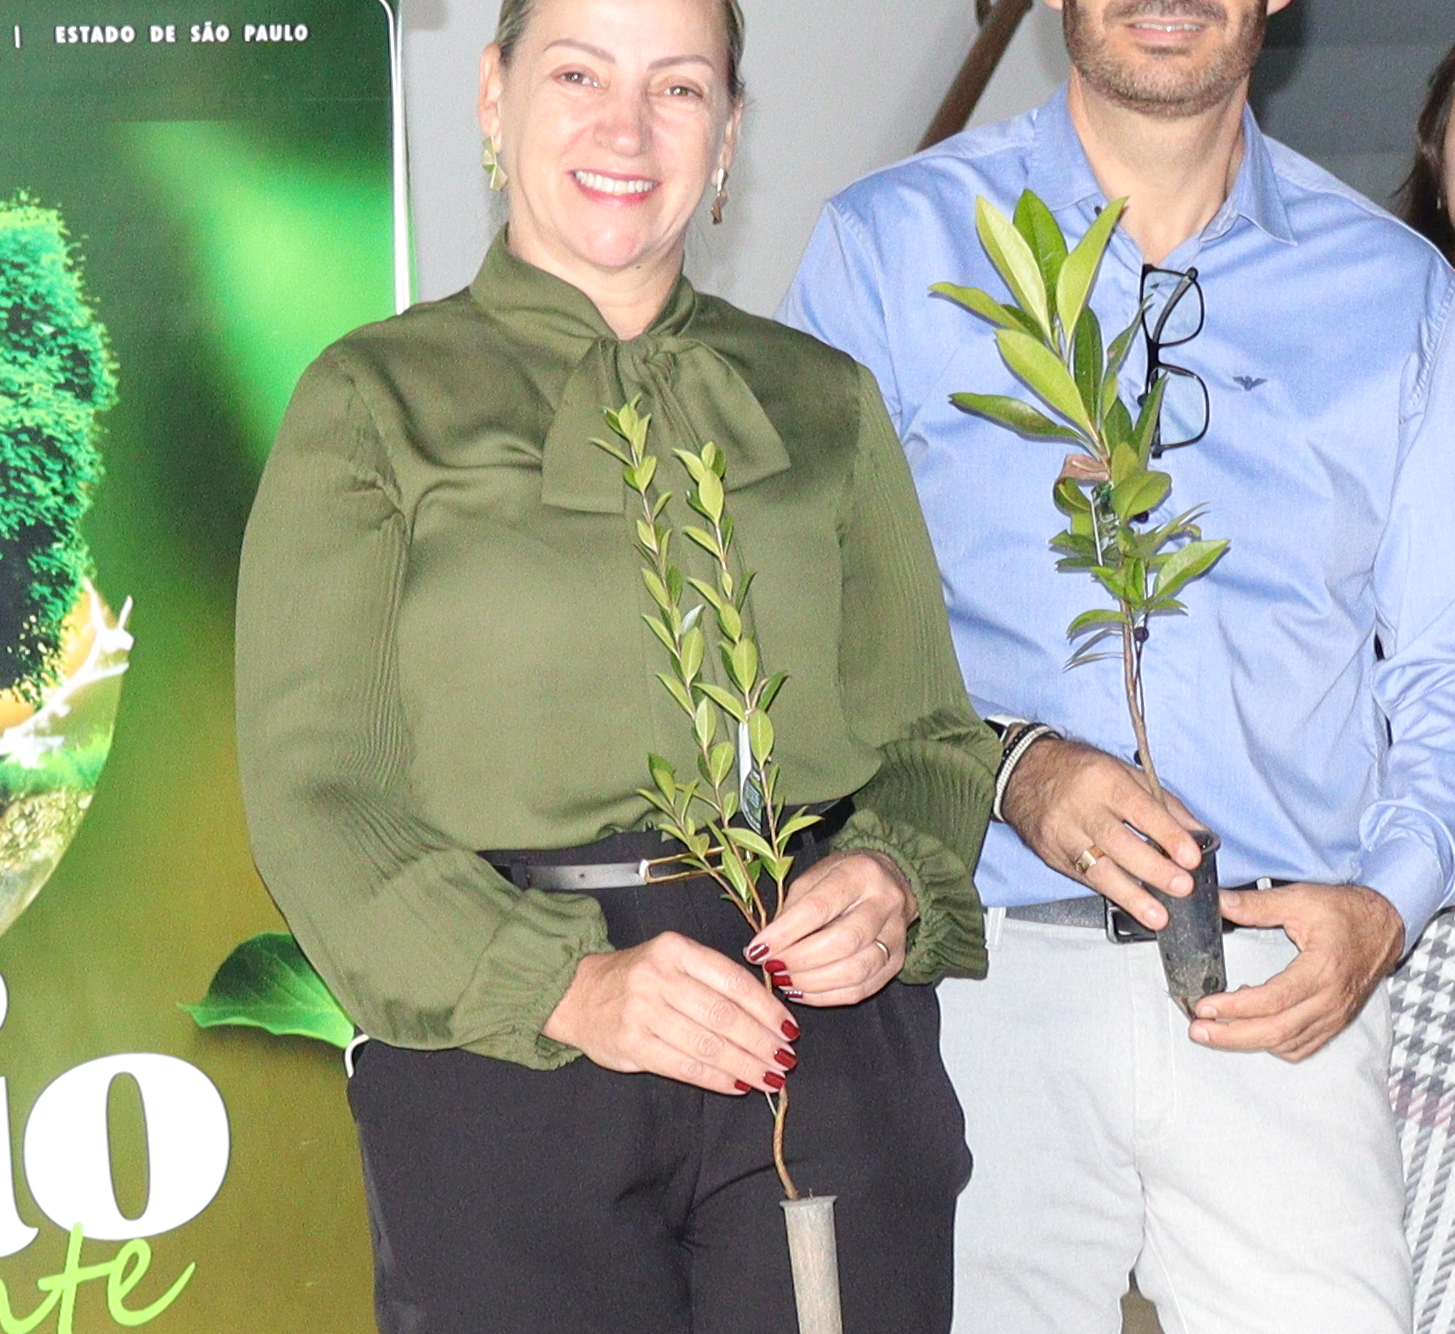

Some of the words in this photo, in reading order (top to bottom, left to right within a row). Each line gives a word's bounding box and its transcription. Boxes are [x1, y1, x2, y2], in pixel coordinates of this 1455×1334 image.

[54, 24, 136, 44] ESTADO
[150, 24, 177, 43] DE
[190, 20, 230, 43] SÃO
[245, 24, 310, 43] PAULO
